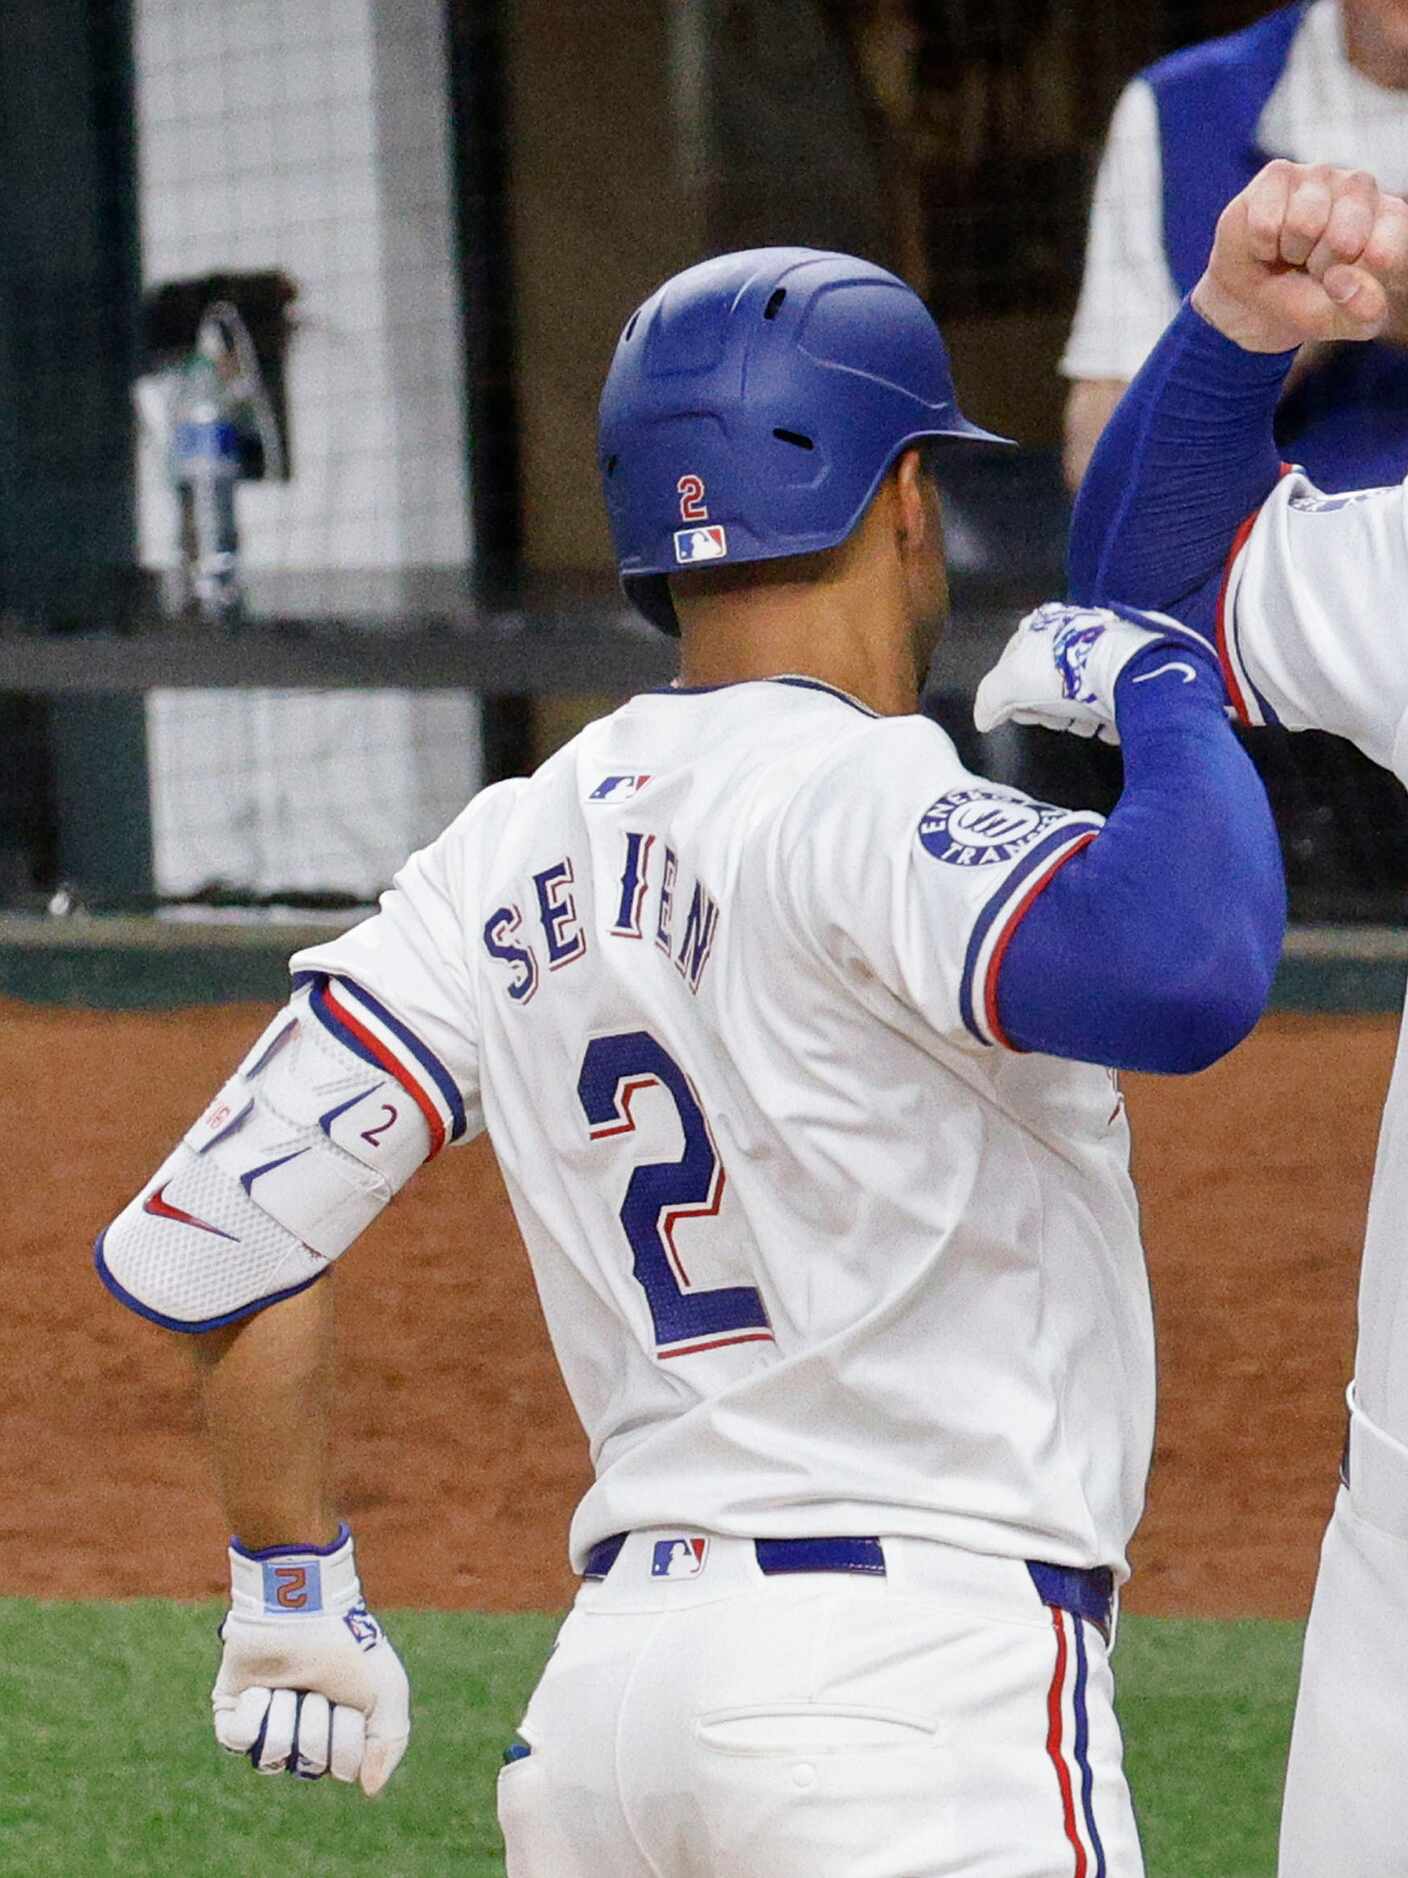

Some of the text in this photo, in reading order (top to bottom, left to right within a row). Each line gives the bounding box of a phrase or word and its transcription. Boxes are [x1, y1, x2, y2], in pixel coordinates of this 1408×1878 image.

[676, 475, 708, 522] 2
[483, 832, 720, 1005] SEIEN
[361, 1103, 398, 1147] 2
[577, 1030, 775, 1360] 2
